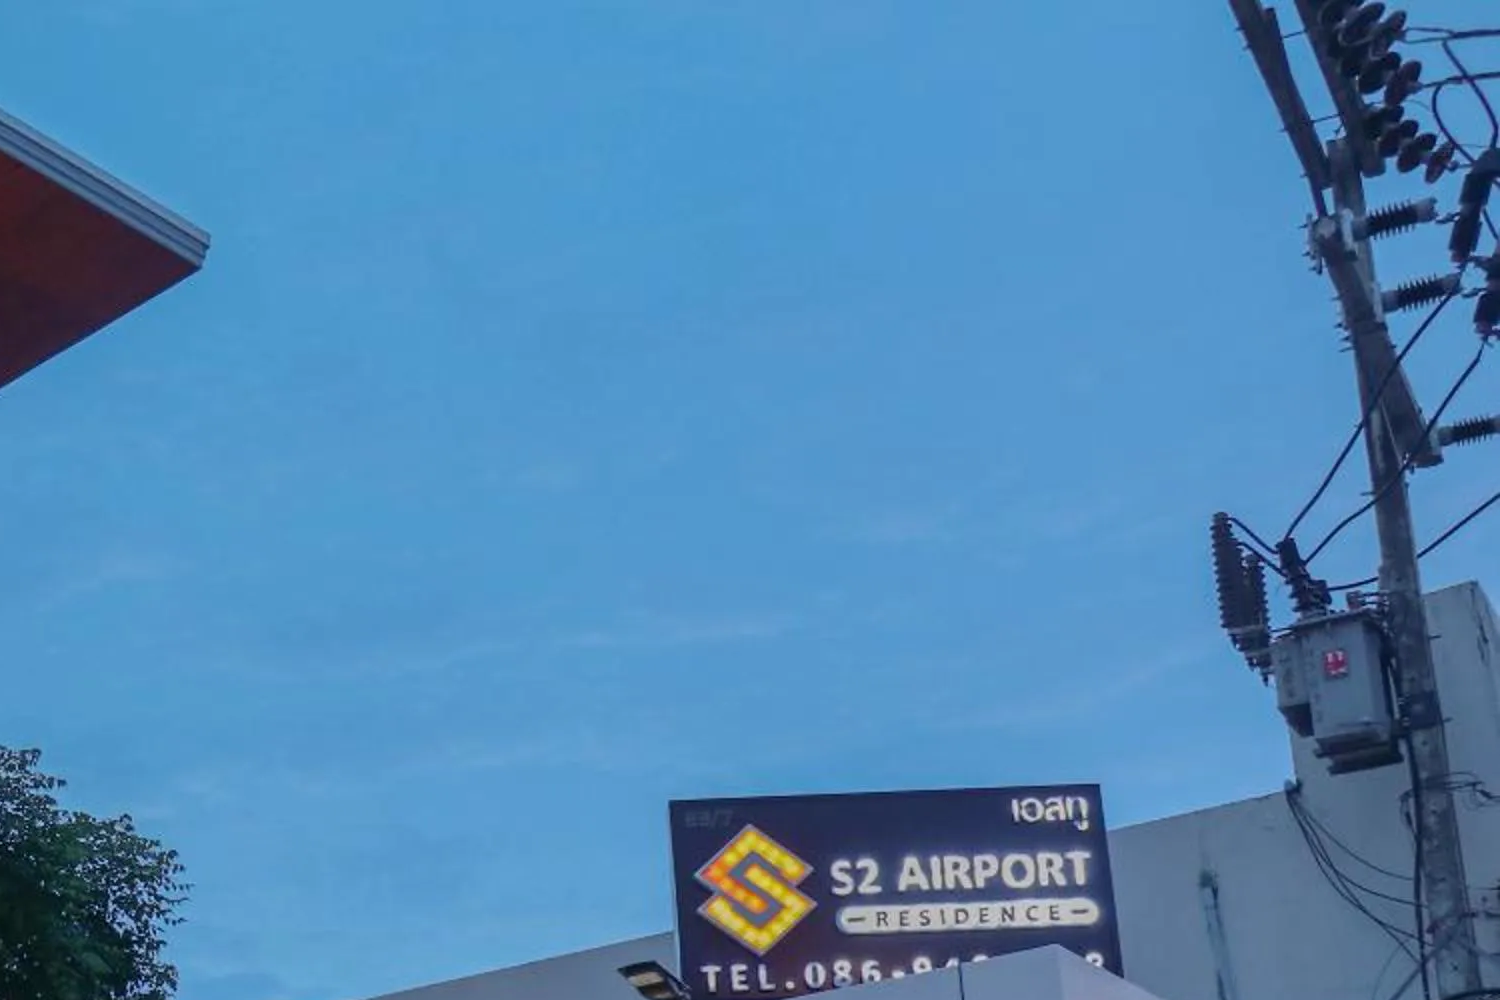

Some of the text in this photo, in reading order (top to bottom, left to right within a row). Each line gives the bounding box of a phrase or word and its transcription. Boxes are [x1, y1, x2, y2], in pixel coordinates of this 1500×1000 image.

[1011, 795, 1089, 831] เอสทู
[830, 851, 1092, 896] S2 AIRPORT
[875, 904, 1061, 928] RESIDENCE
